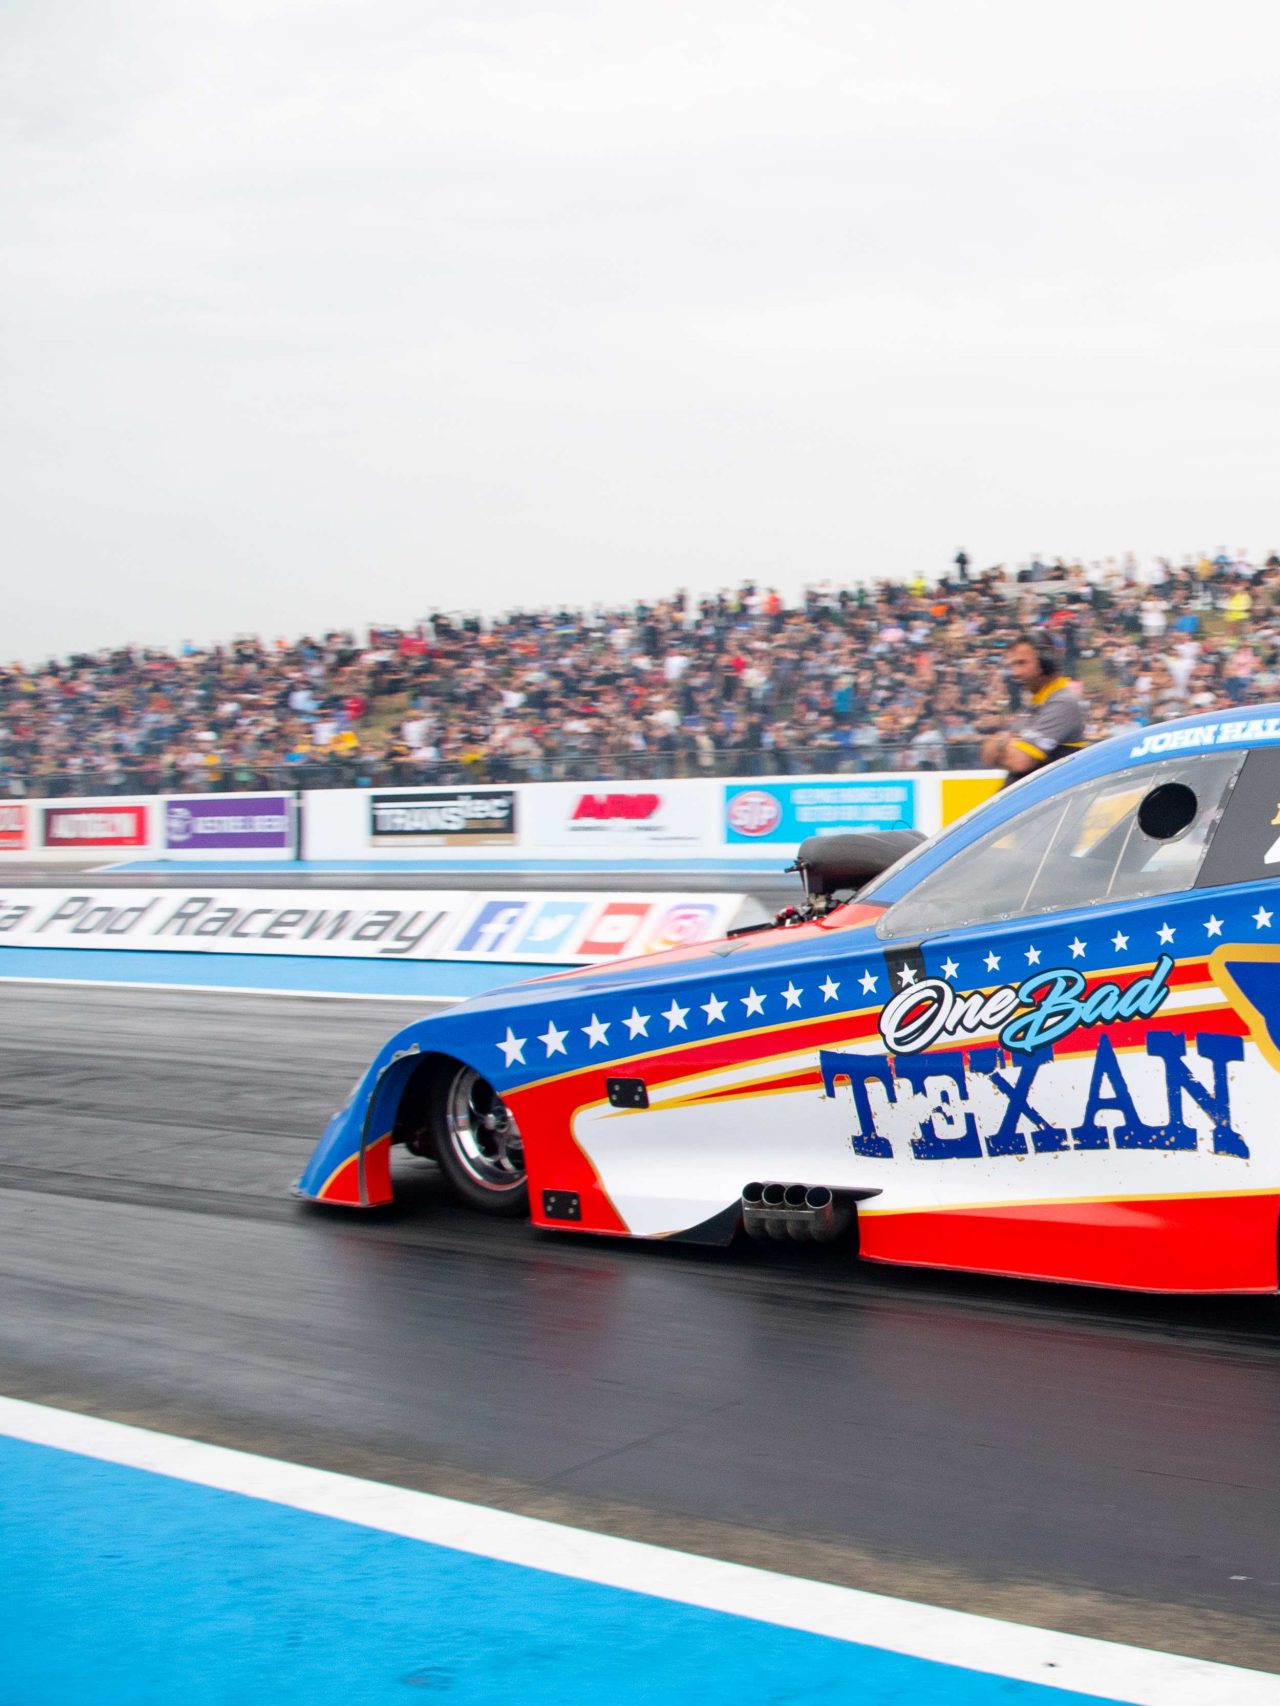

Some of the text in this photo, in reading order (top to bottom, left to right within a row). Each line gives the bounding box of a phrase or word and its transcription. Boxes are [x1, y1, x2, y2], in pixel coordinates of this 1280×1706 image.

[1129, 724, 1219, 758] JOHN
[34, 896, 164, 935] Pod
[152, 897, 450, 954] Raceway
[880, 953, 1175, 1055] One Bad
[818, 1030, 1251, 1160] TEXAN
